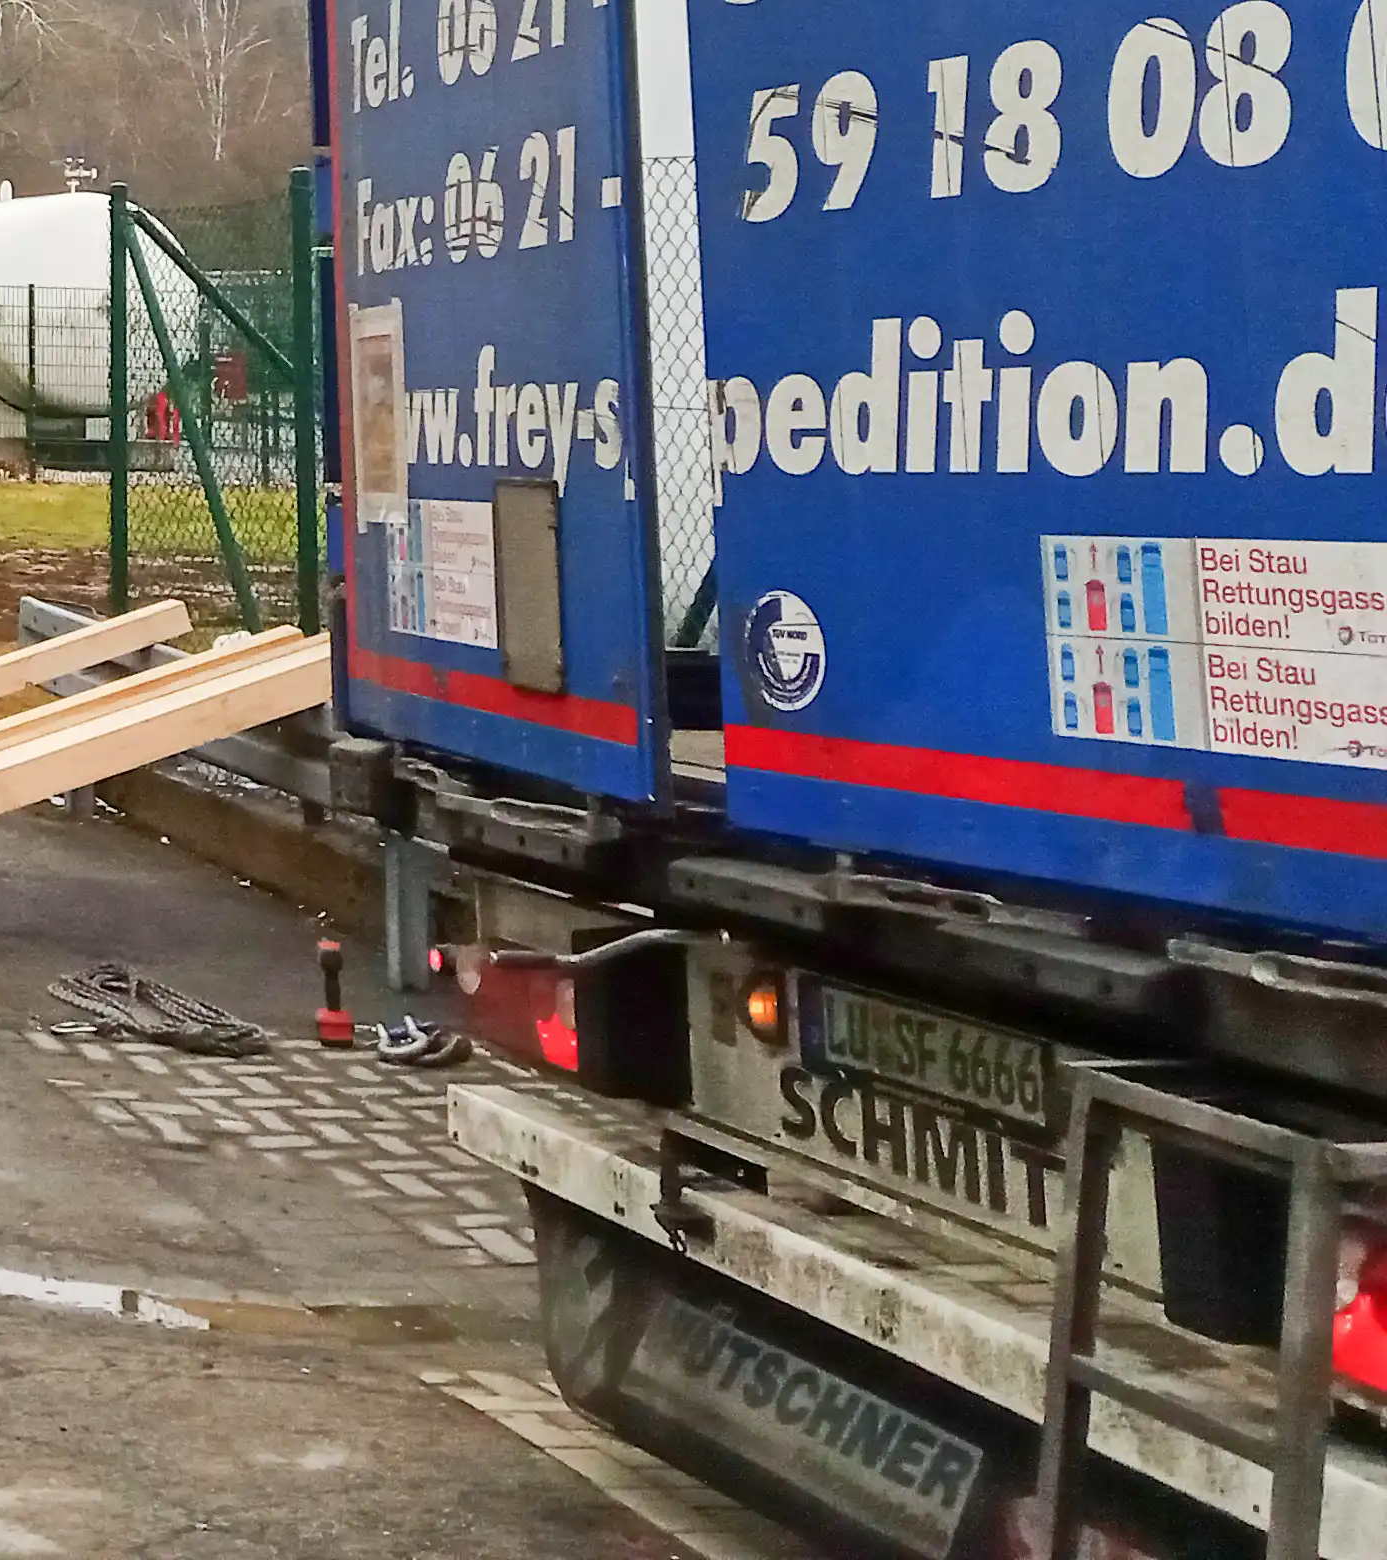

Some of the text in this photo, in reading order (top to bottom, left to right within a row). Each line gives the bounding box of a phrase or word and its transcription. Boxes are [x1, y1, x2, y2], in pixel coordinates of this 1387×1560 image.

[742, 70, 879, 223] 59
[927, 39, 1062, 198] 18
[1107, 0, 1292, 179] 08
[357, 178, 435, 276] Fax:
[444, 146, 505, 264] 06
[519, 125, 576, 249] 21
[1200, 546, 1308, 575] Bei Stau
[1205, 610, 1291, 639] bilden!
[1208, 653, 1317, 686] Bei Stau
[1212, 716, 1299, 750] bilden!
[894, 1012, 939, 1078] SF
[779, 1066, 1068, 1229] SCHMIT
